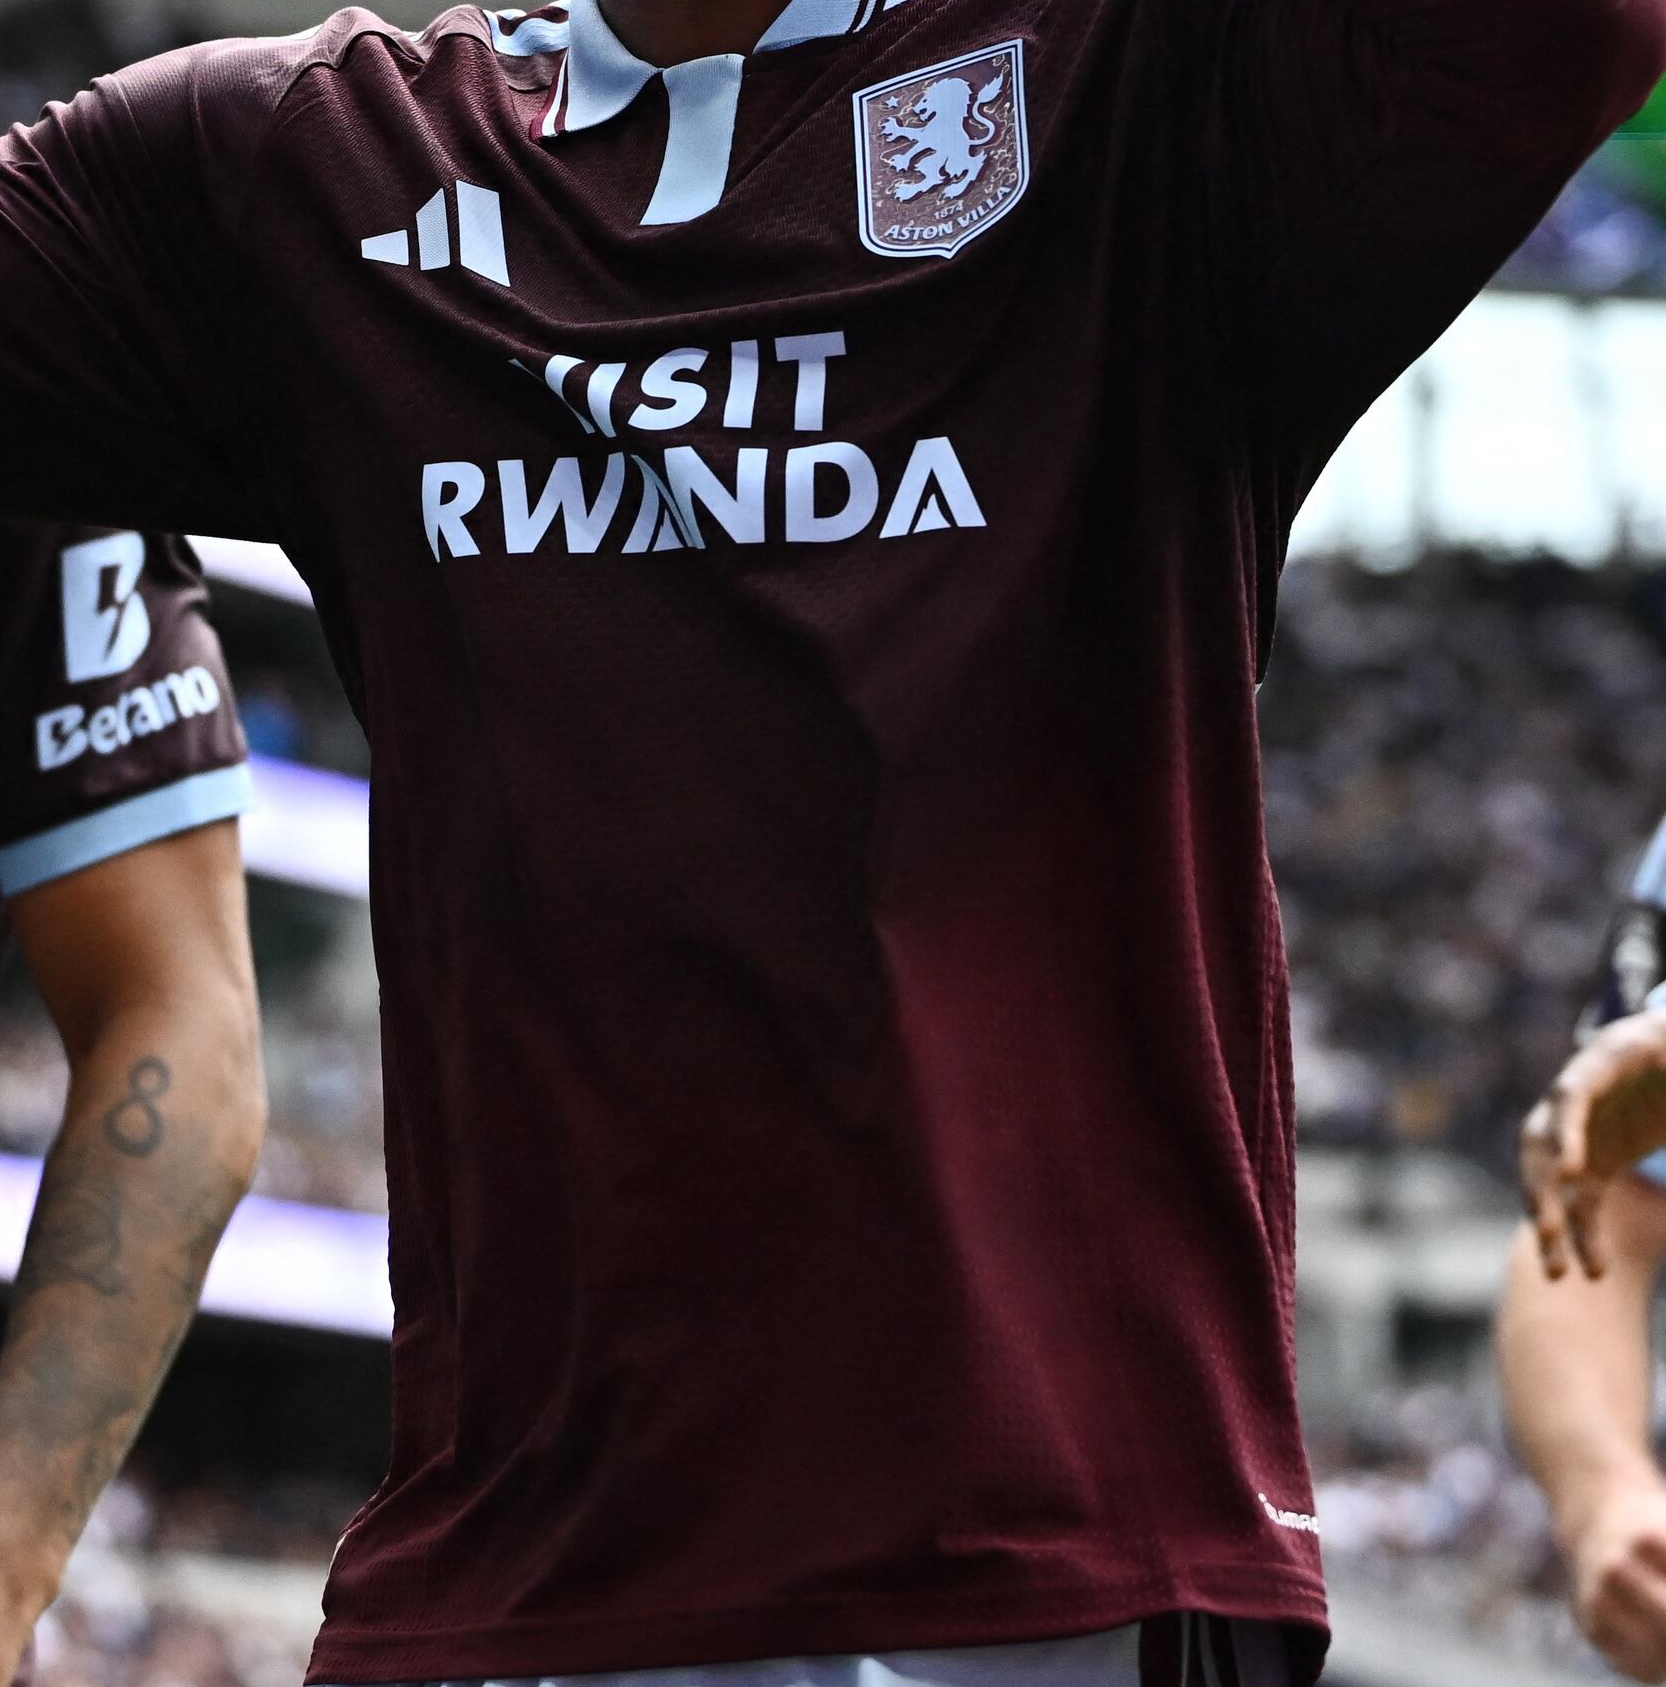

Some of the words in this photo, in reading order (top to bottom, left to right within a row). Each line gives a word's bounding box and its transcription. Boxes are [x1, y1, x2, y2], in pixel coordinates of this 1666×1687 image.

[884, 220, 954, 241] ASTON
[957, 185, 1011, 228] VILLA
[421, 436, 988, 563] RWANDA
[36, 666, 221, 771] Betano
